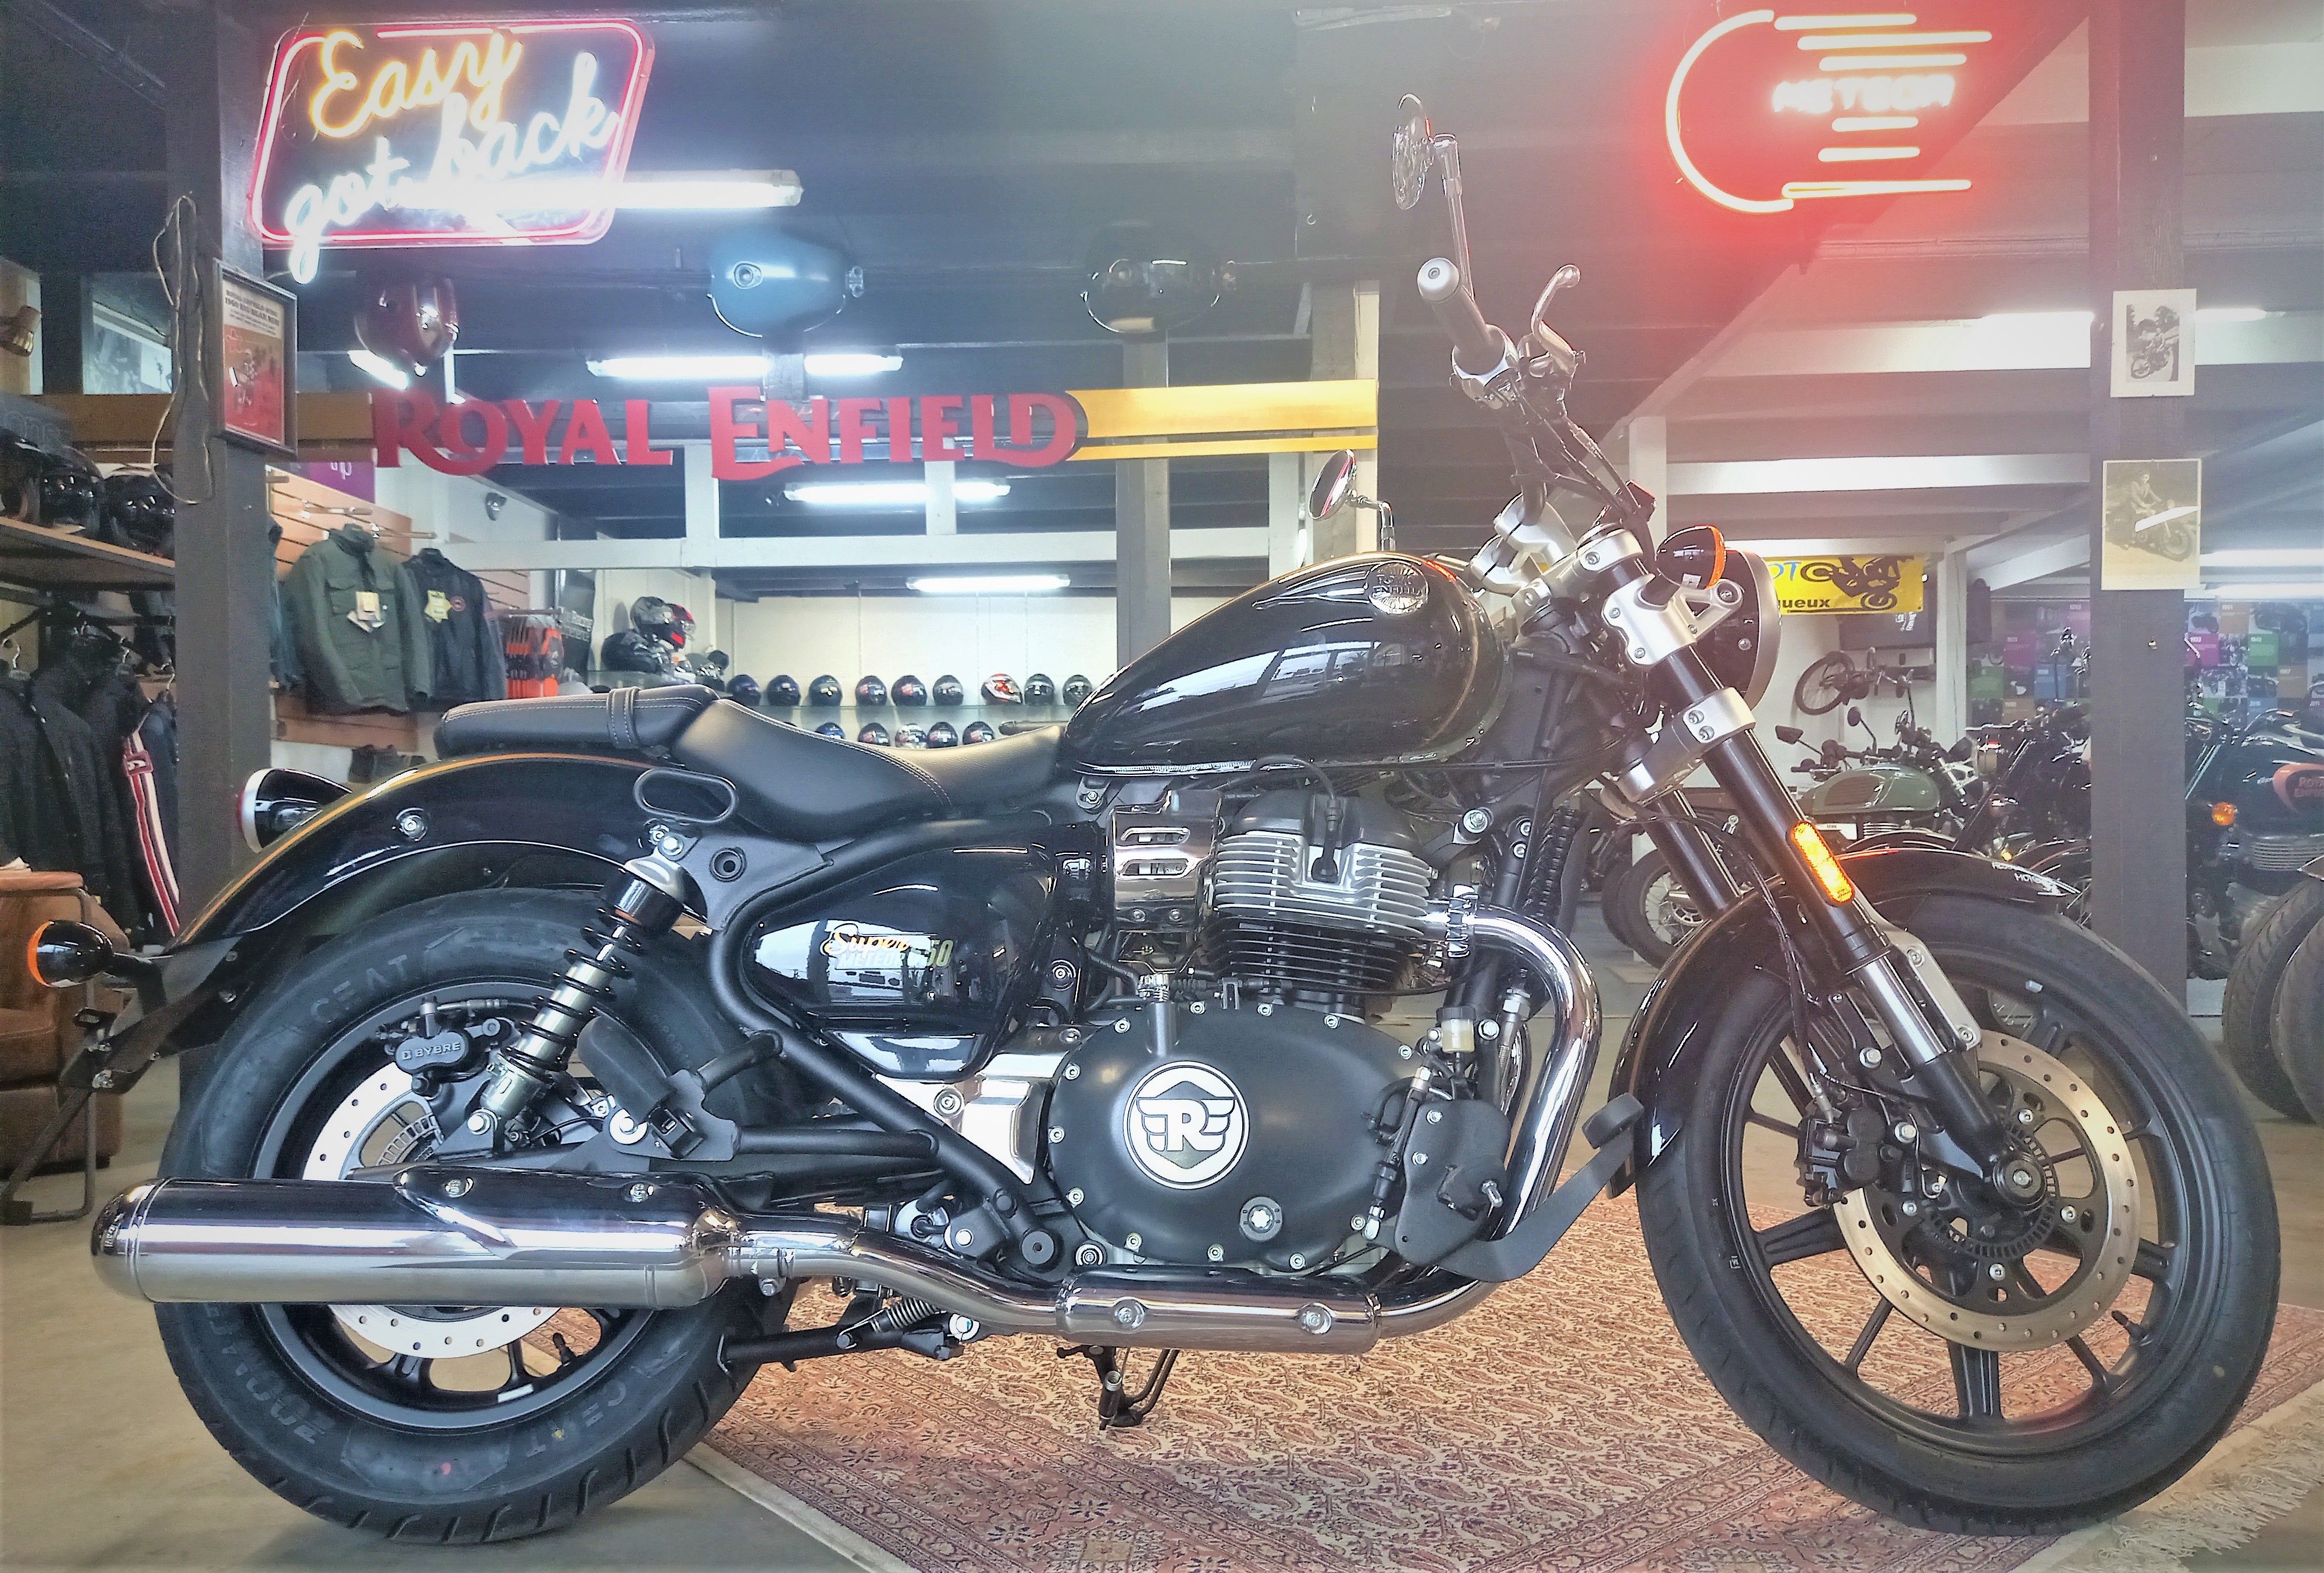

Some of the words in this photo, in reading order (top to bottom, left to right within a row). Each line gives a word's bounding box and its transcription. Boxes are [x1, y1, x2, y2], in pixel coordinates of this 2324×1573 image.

[311, 30, 522, 138] Easy
[1773, 74, 1955, 113] METEOR
[285, 136, 412, 284] got
[428, 51, 620, 182] back
[372, 387, 673, 476] ROYAL
[708, 385, 1077, 481] ENFIELD
[1778, 598, 1831, 608] ueux
[822, 931, 912, 956] Super
[840, 952, 906, 968] METEOR
[311, 954, 408, 1023] CEAT
[415, 1041, 462, 1058] BYBRE
